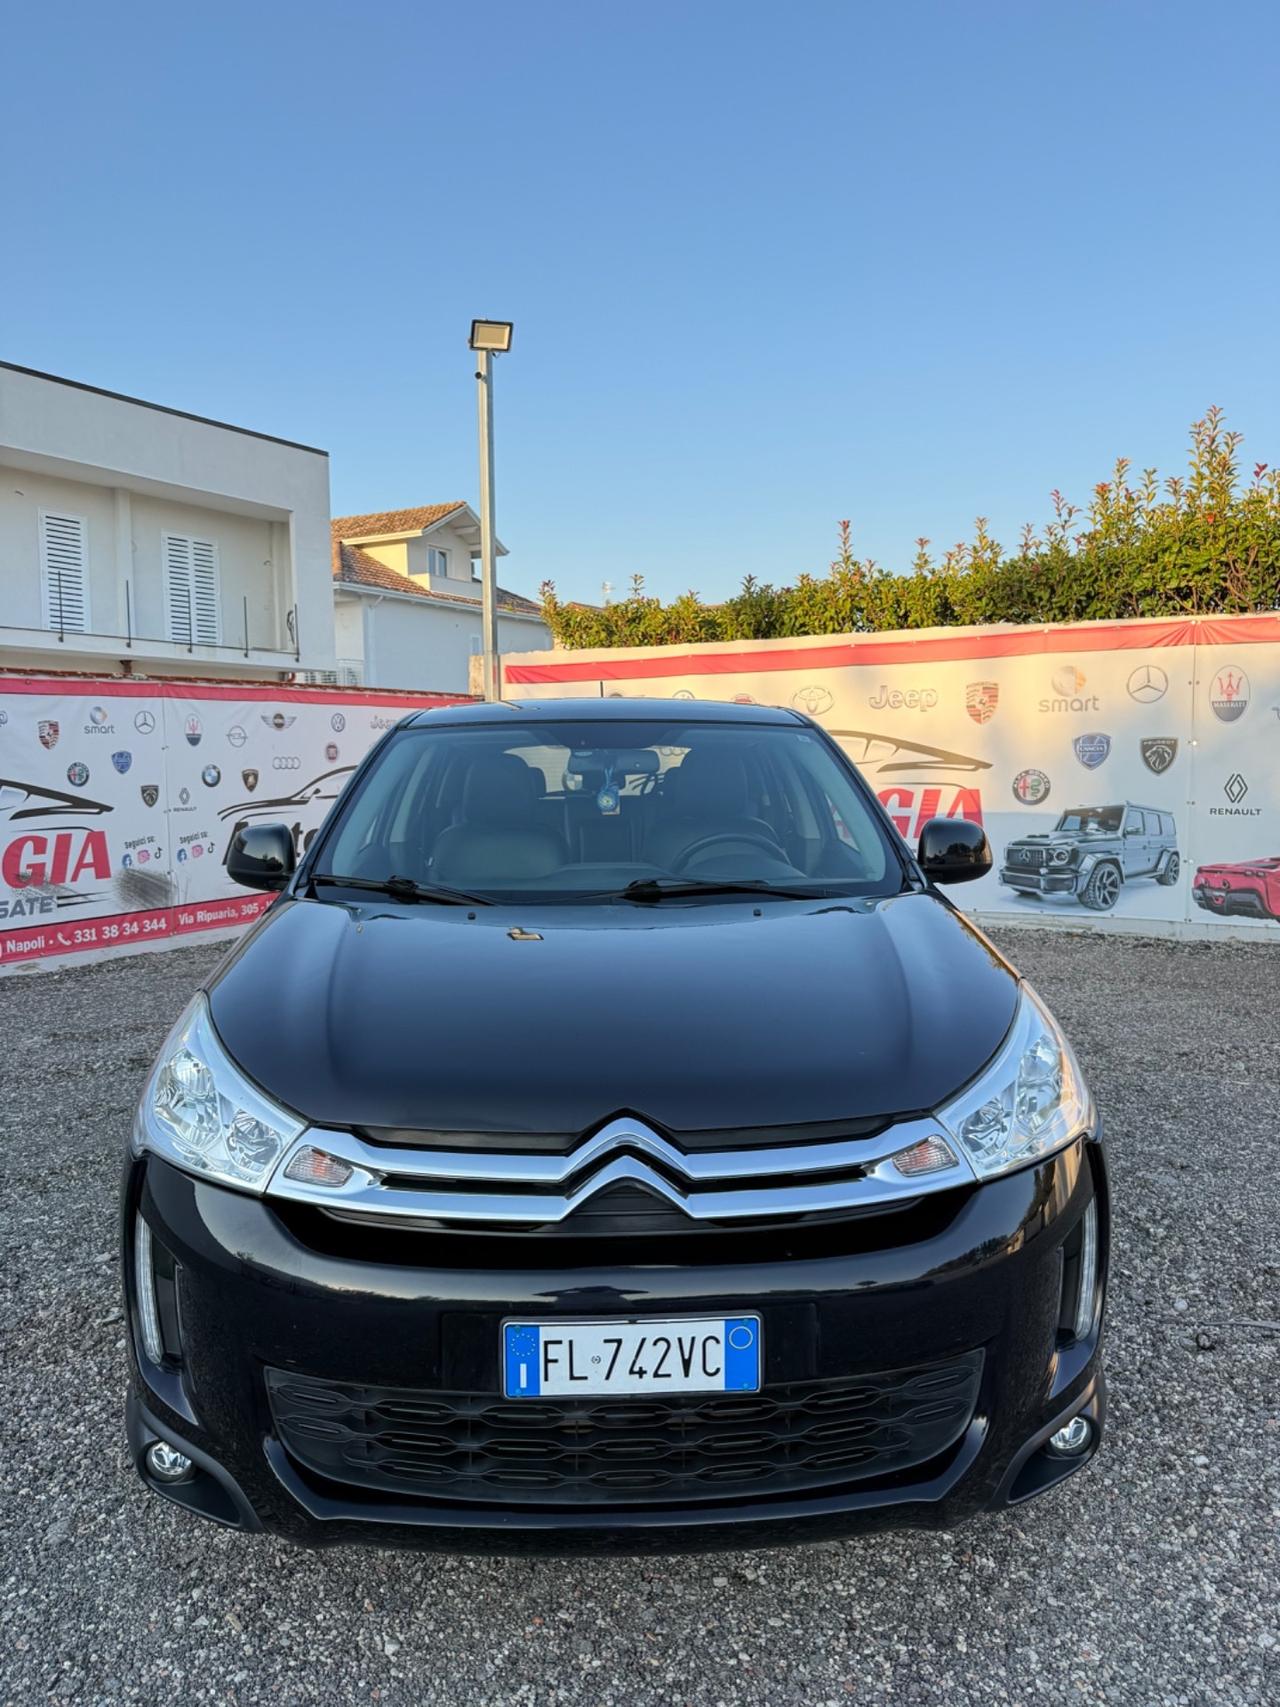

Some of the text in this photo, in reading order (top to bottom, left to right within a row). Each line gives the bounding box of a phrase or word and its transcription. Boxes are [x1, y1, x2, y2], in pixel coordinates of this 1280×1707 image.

[868, 684, 938, 712] Jeep
[1038, 695, 1100, 713] smart
[83, 724, 115, 734] smart
[370, 715, 396, 729] Jee
[1209, 807, 1262, 816] RENAULT
[2, 831, 112, 889] GIA
[178, 914, 193, 925] Via
[196, 906, 239, 923] Ripuaria,
[241, 902, 259, 915] 305
[6, 936, 45, 953] Napoli
[73, 928, 98, 943] 331
[101, 925, 119, 939] 38
[122, 922, 139, 935] 34
[143, 918, 167, 932] 344
